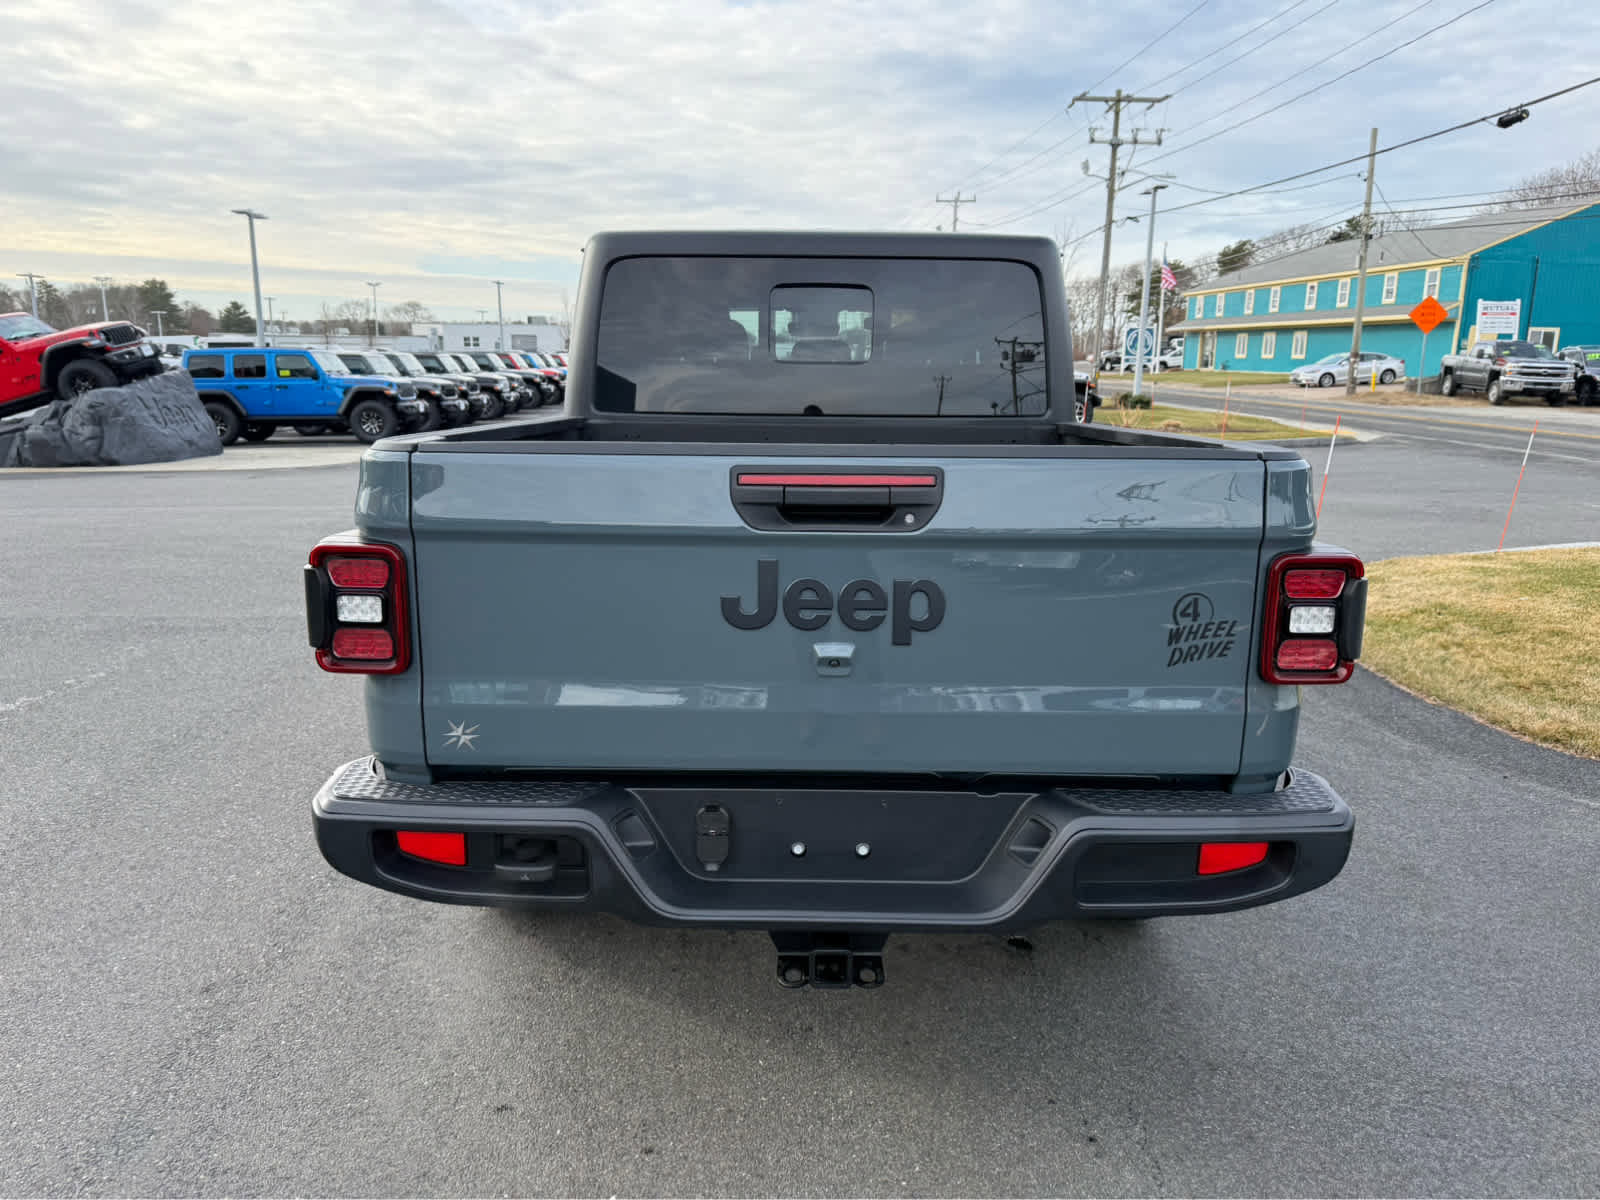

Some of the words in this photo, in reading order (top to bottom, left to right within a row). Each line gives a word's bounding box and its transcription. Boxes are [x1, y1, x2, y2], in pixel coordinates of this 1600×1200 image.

[720, 560, 946, 646] Jeep
[1179, 597, 1201, 622] 4
[1167, 620, 1239, 647] WHEEL
[1167, 640, 1235, 668] DRIVE
